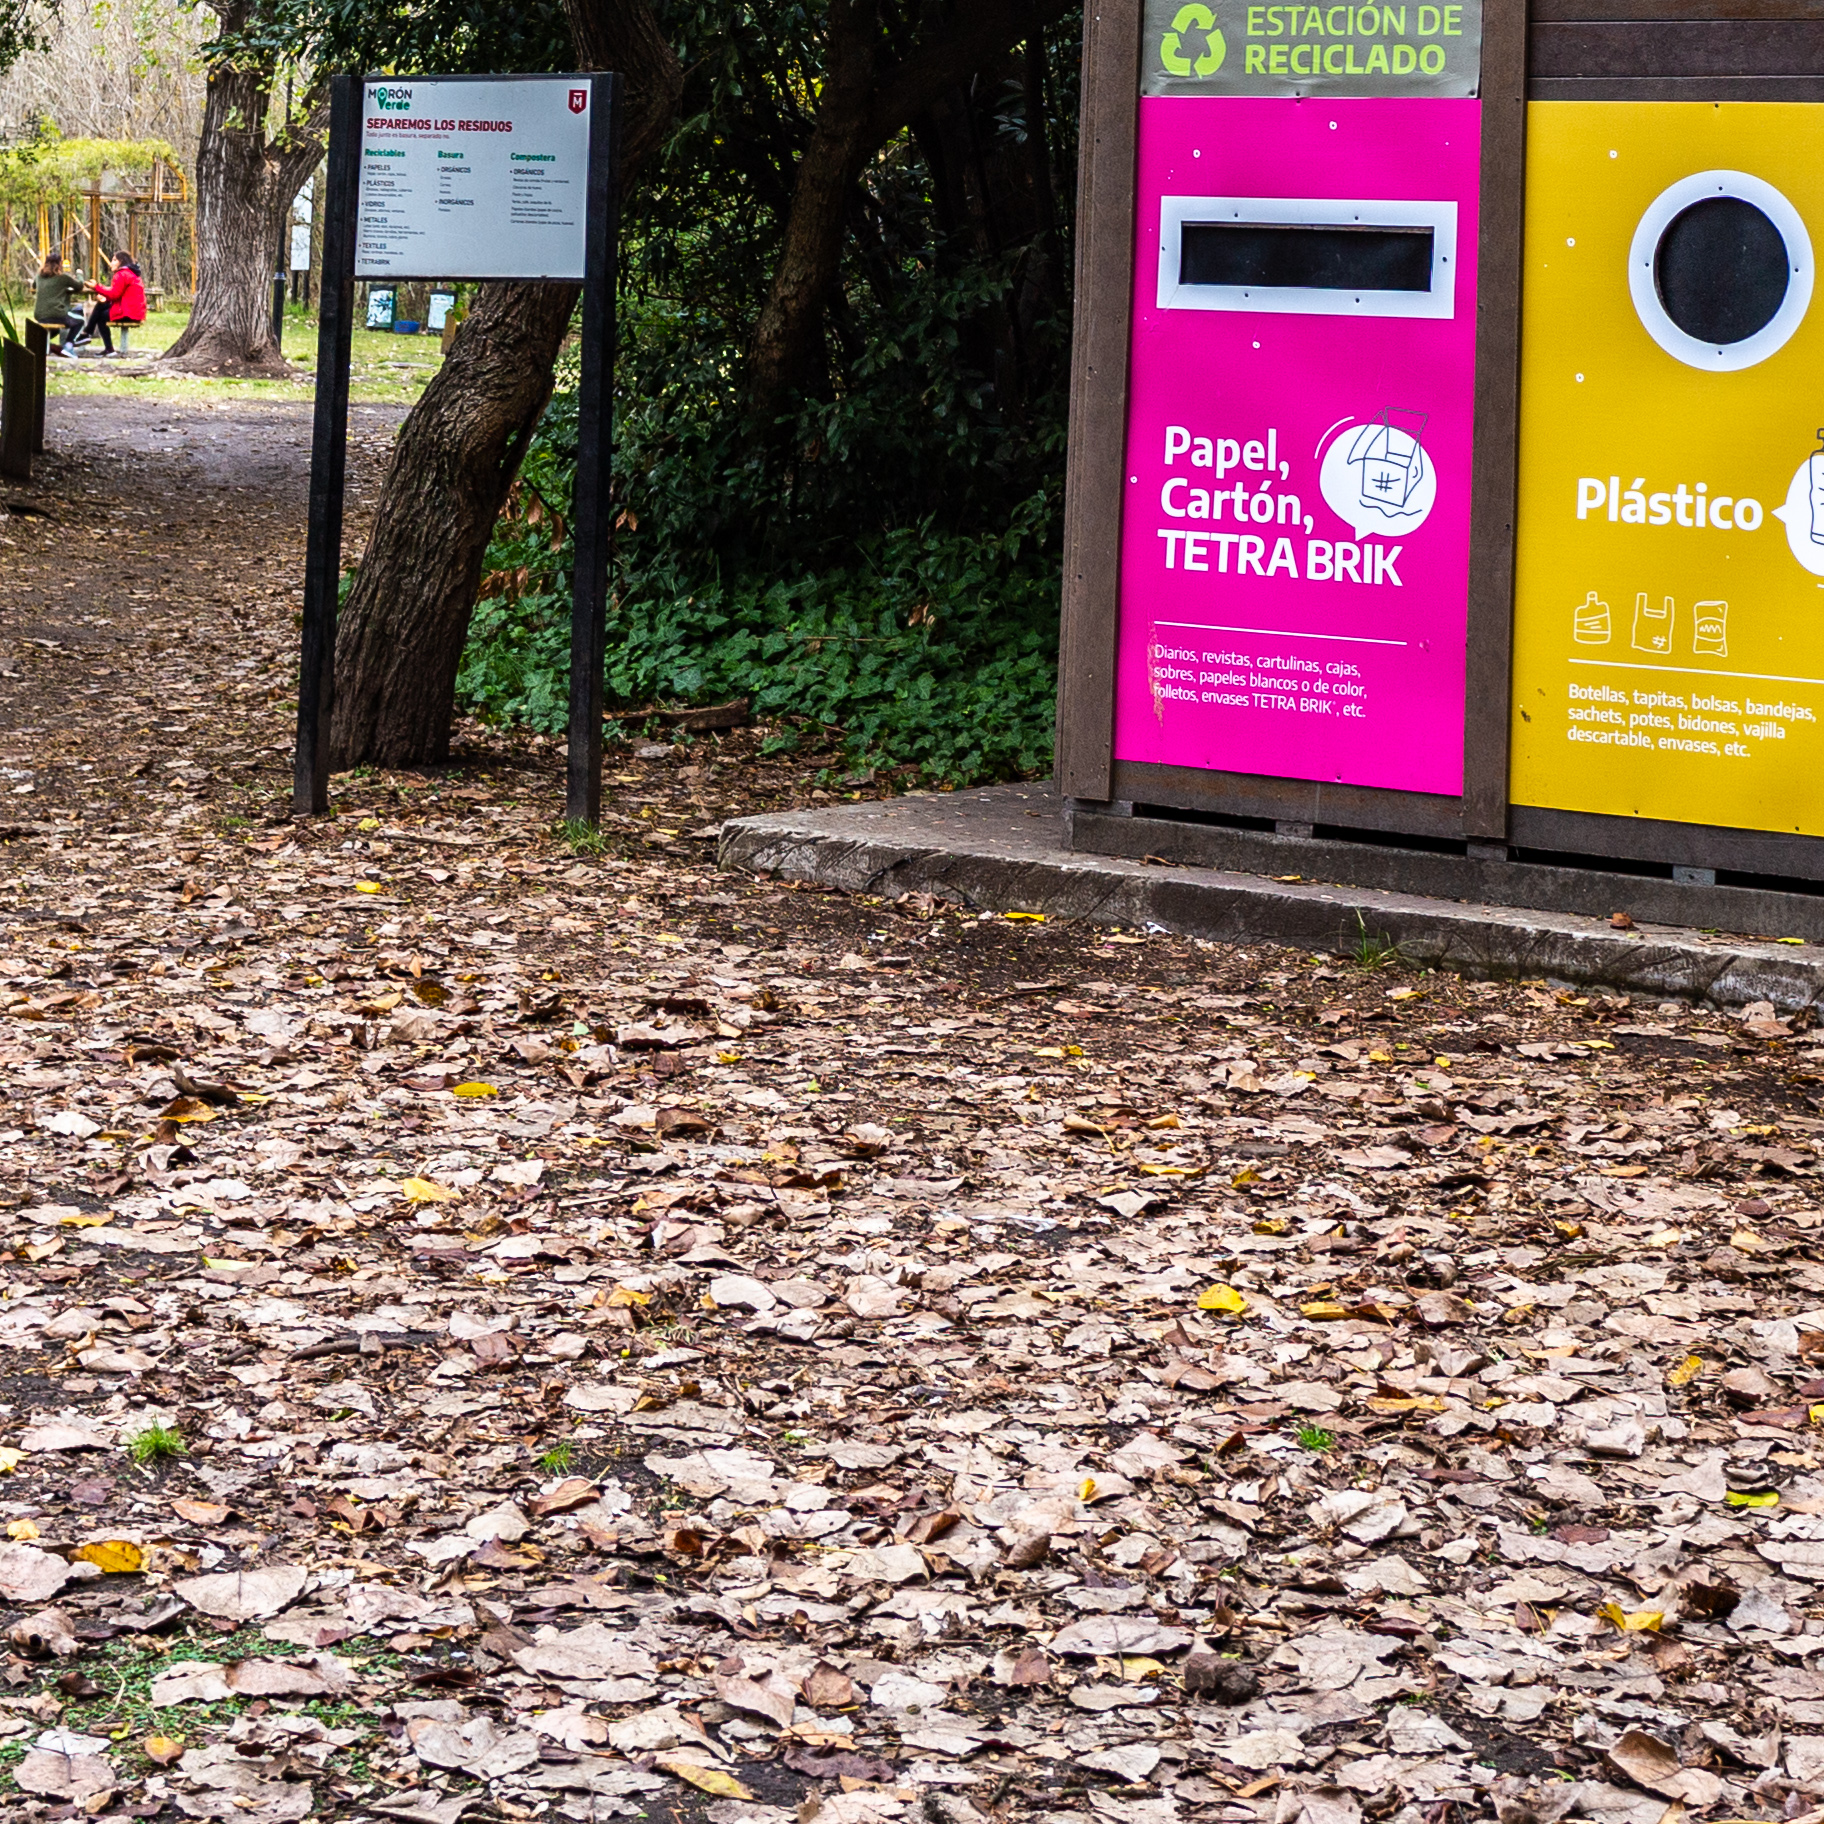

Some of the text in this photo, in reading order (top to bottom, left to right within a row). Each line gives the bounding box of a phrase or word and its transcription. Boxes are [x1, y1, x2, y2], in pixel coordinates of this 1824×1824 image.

[1417, 4, 1462, 37] DE
[1245, 44, 1446, 75] RECICLADO
[366, 118, 512, 132] SEPAREMOS LOS RESIDUOS
[364, 149, 406, 157] Reciclables
[438, 150, 464, 159] Basura
[510, 153, 556, 162] Compostera
[1165, 426, 1289, 480] Papel,
[1161, 478, 1313, 534] Cartón,
[1577, 476, 1763, 531] Plástico
[1158, 529, 1402, 586] TETRA BRIK
[1154, 644, 1360, 677] Diarios, revistas, cartulinas, cajas,
[1153, 664, 1367, 698] sobres, papeles blancos o de color,
[1154, 683, 1199, 703] folletos,
[1202, 692, 1249, 706] envases
[1252, 693, 1296, 710] TETRA
[1343, 703, 1365, 717] etc.
[1569, 684, 1816, 722] Botellas, tapitas, bolsas, bandejas,
[1568, 706, 1785, 740] sachets, potes, bidones, vajilla
[1567, 725, 1750, 757] descartable, envases, etc.
